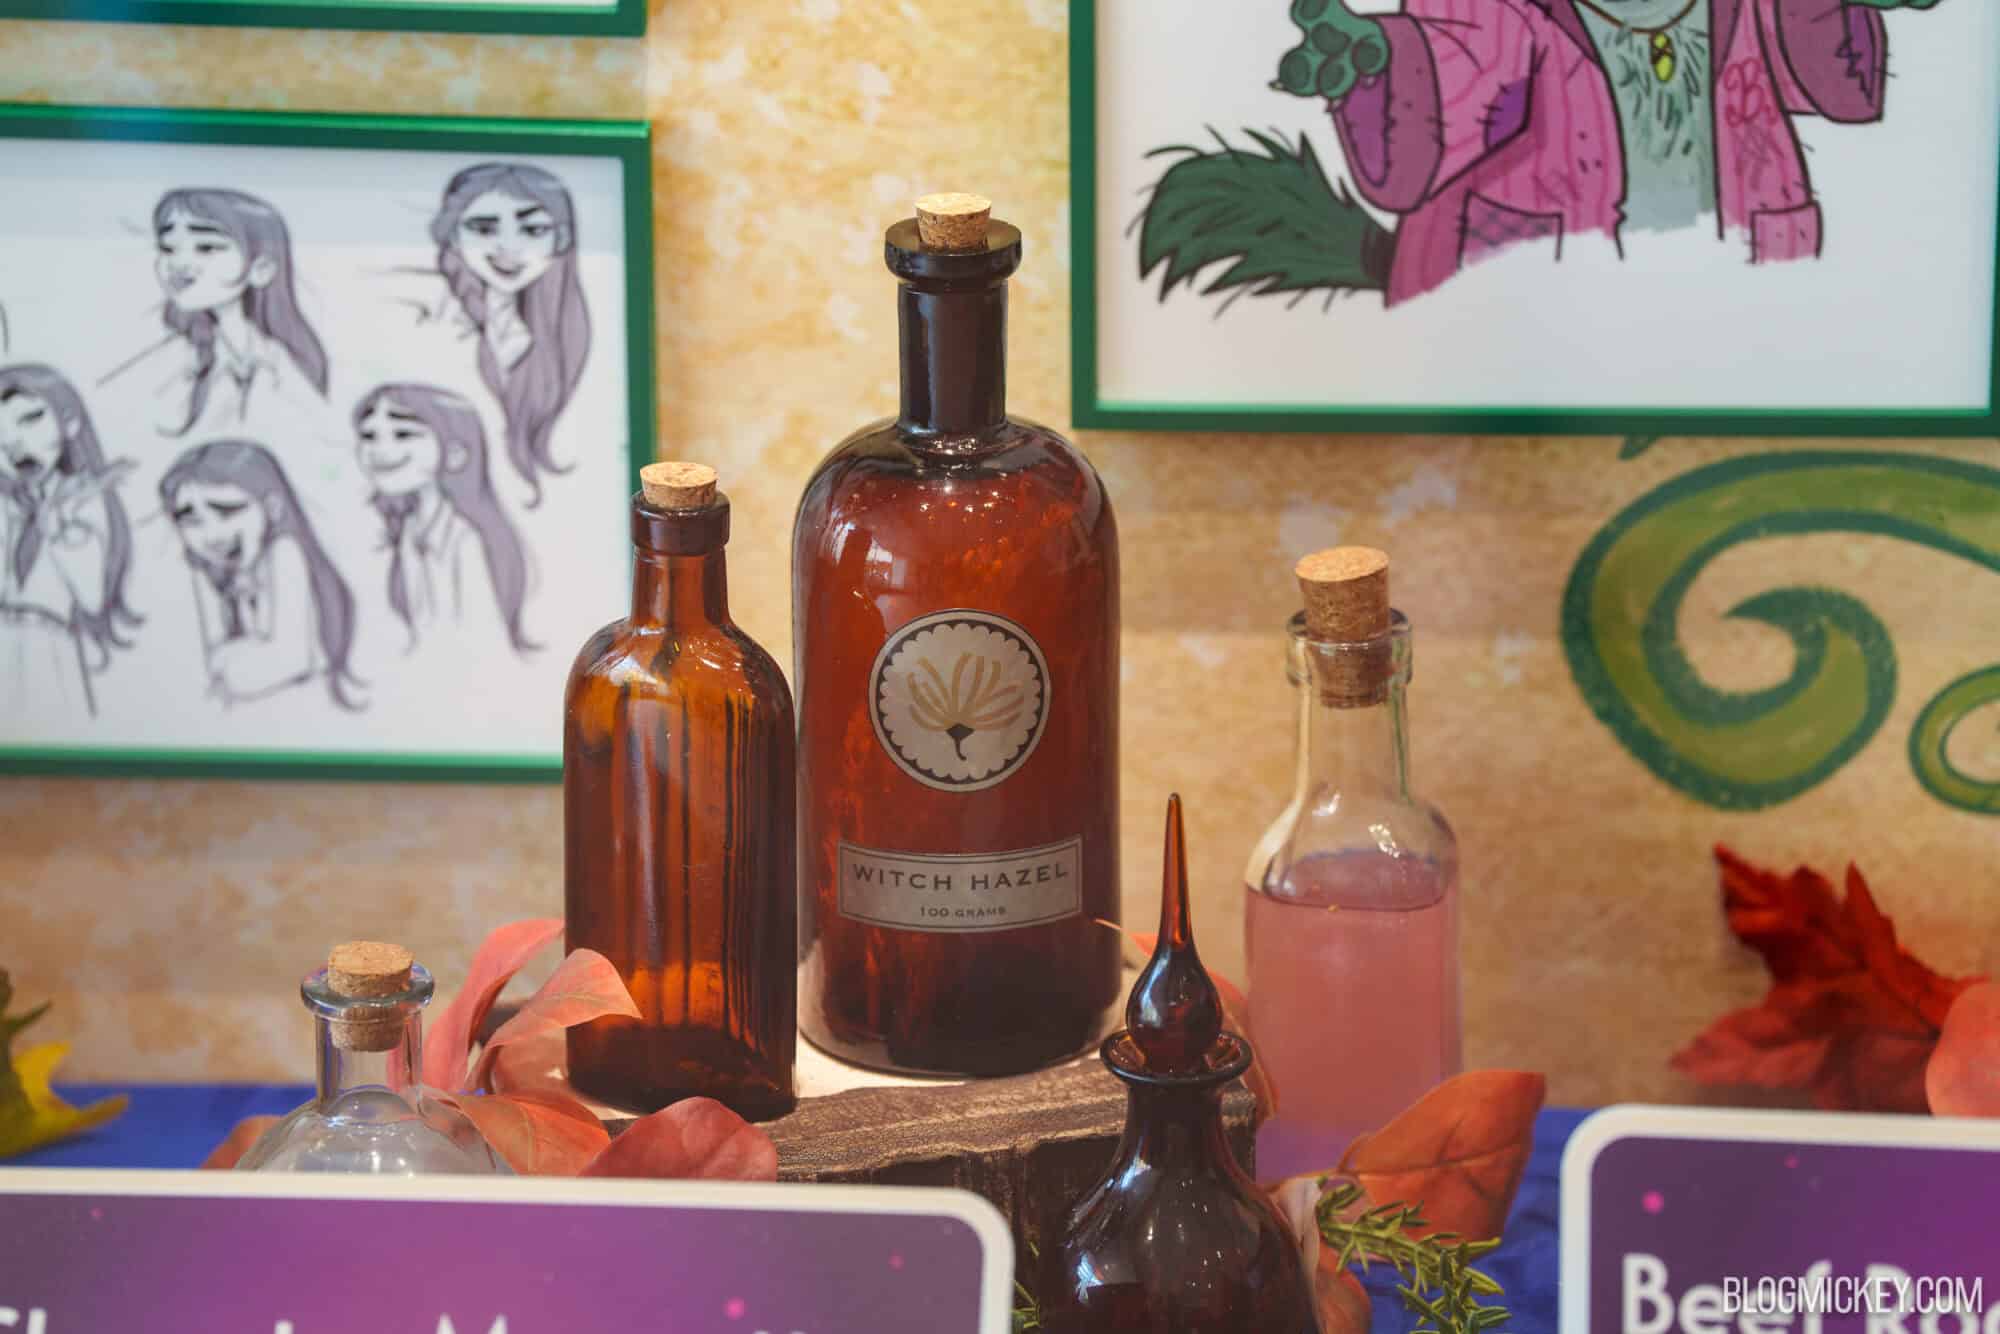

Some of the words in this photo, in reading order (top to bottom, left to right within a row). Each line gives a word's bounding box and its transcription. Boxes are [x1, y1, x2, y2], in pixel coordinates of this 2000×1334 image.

[852, 863, 953, 891] WITCH
[970, 862, 1069, 891] HAZEL
[920, 906, 950, 917] 100
[954, 906, 1007, 918] GRAMS
[1623, 1253, 1832, 1334] Beef
[1865, 1263, 2000, 1334] Ro
